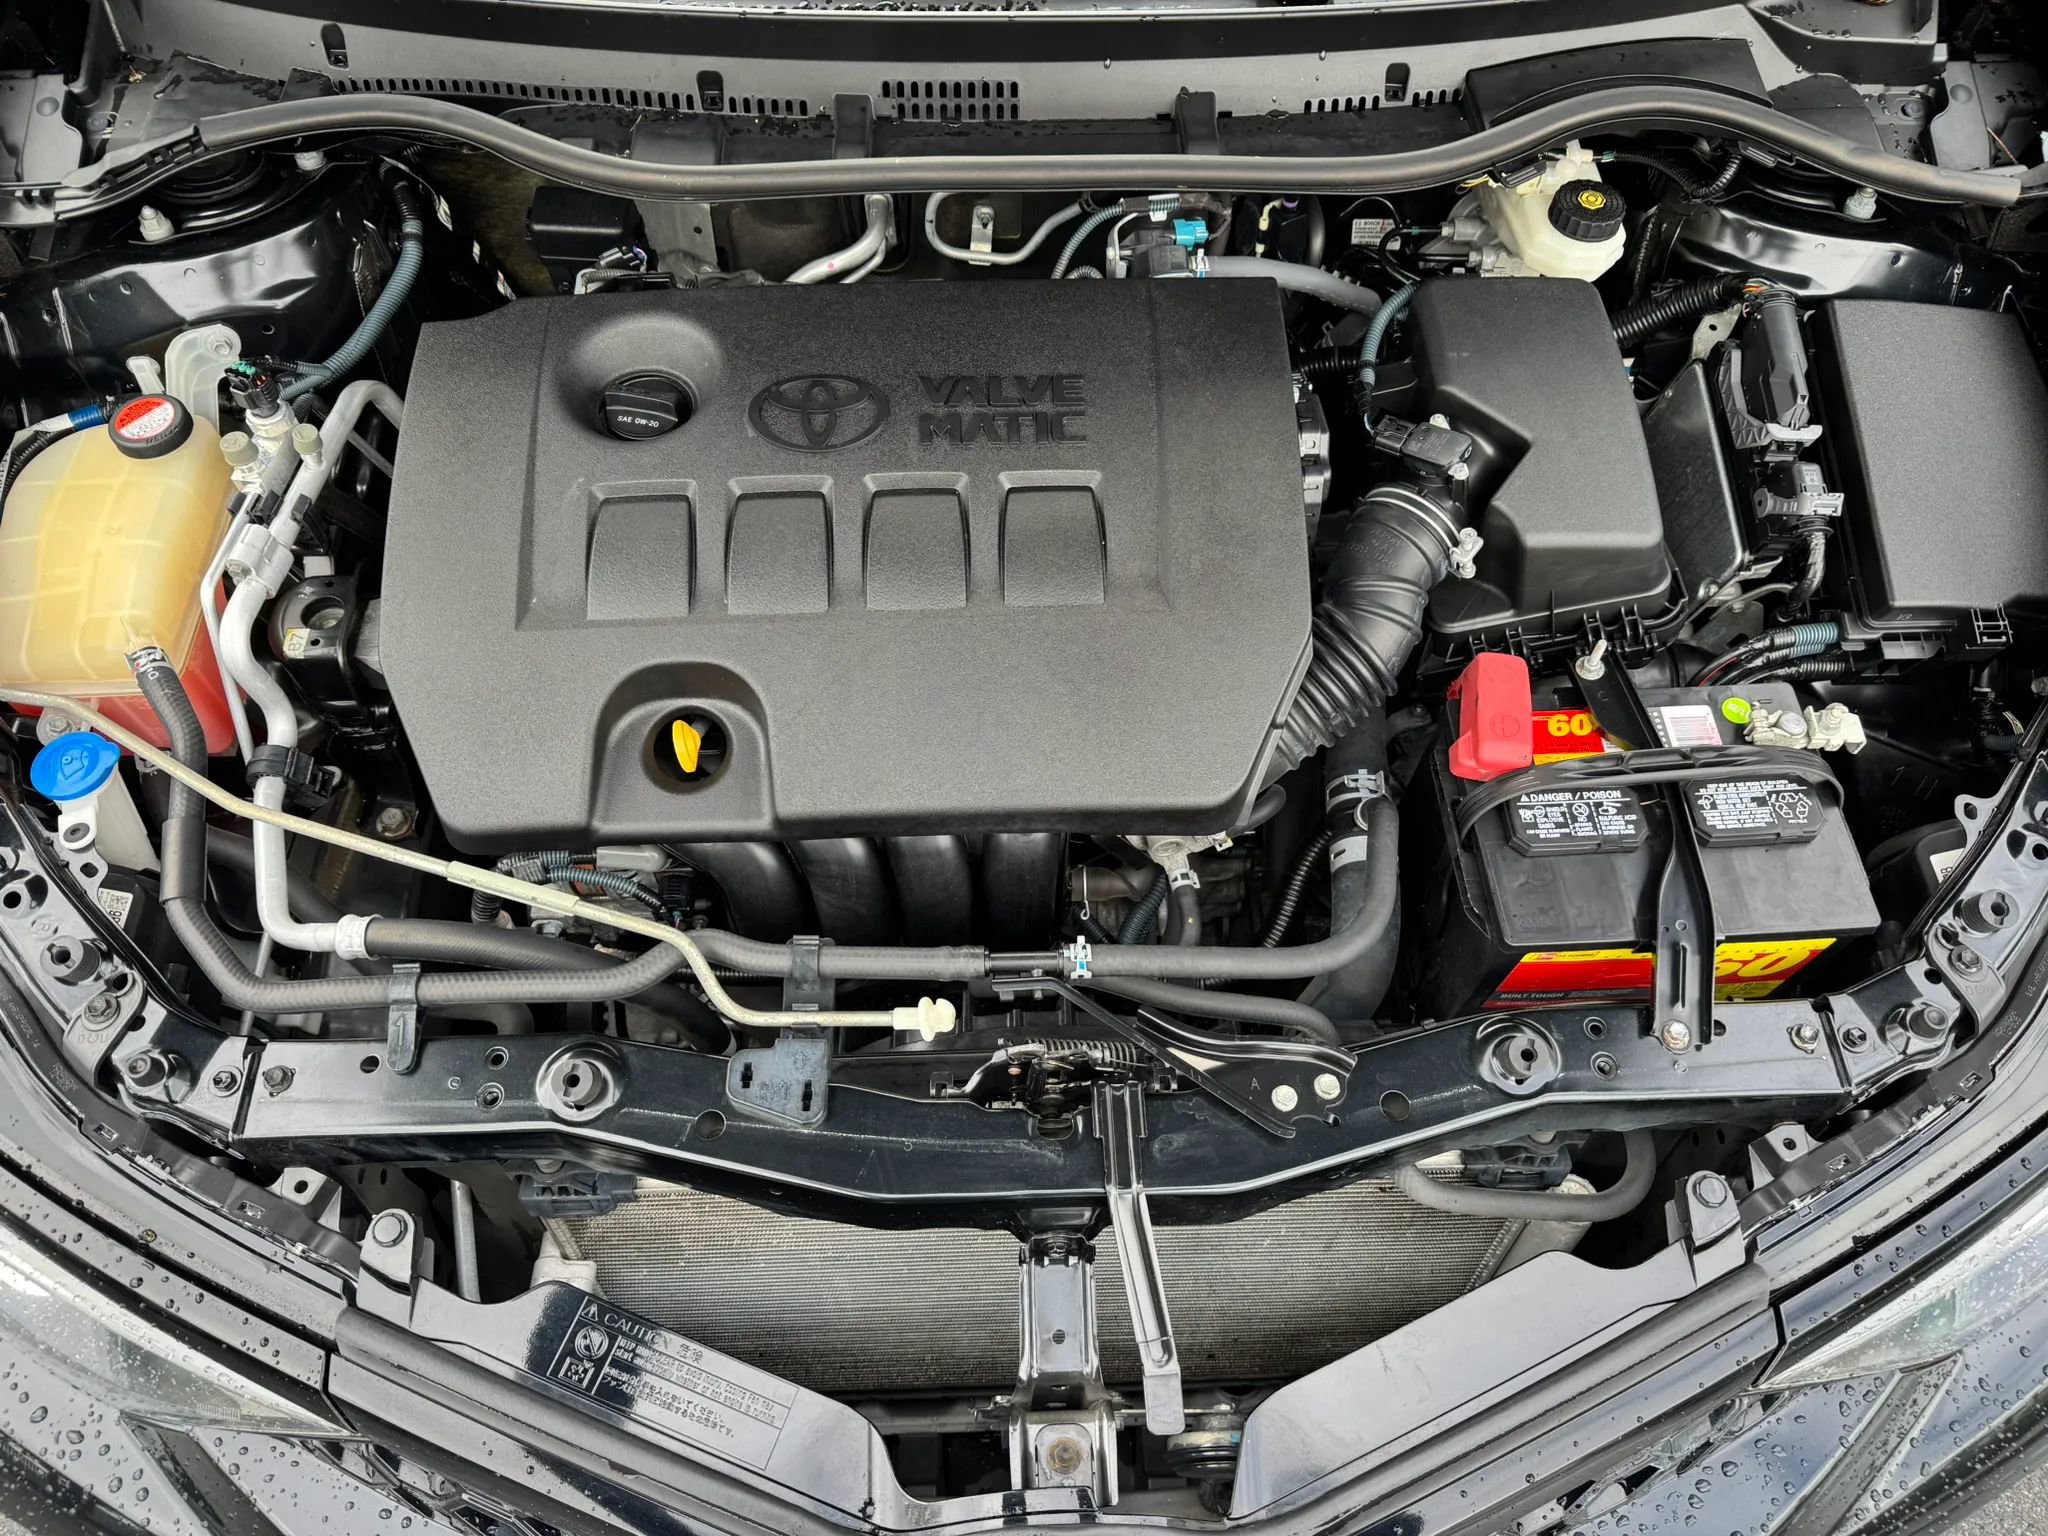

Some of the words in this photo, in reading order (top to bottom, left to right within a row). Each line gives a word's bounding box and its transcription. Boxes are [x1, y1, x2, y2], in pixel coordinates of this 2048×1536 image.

[919, 375, 1085, 407] VALVE
[617, 415, 632, 423] SAE
[635, 417, 660, 428] 0W-20
[919, 412, 1087, 445] MATIC
[1547, 713, 1593, 737] 60
[1530, 792, 1573, 802] DANGER
[1582, 790, 1621, 799] POISON
[604, 1312, 672, 1350] CAUTION
